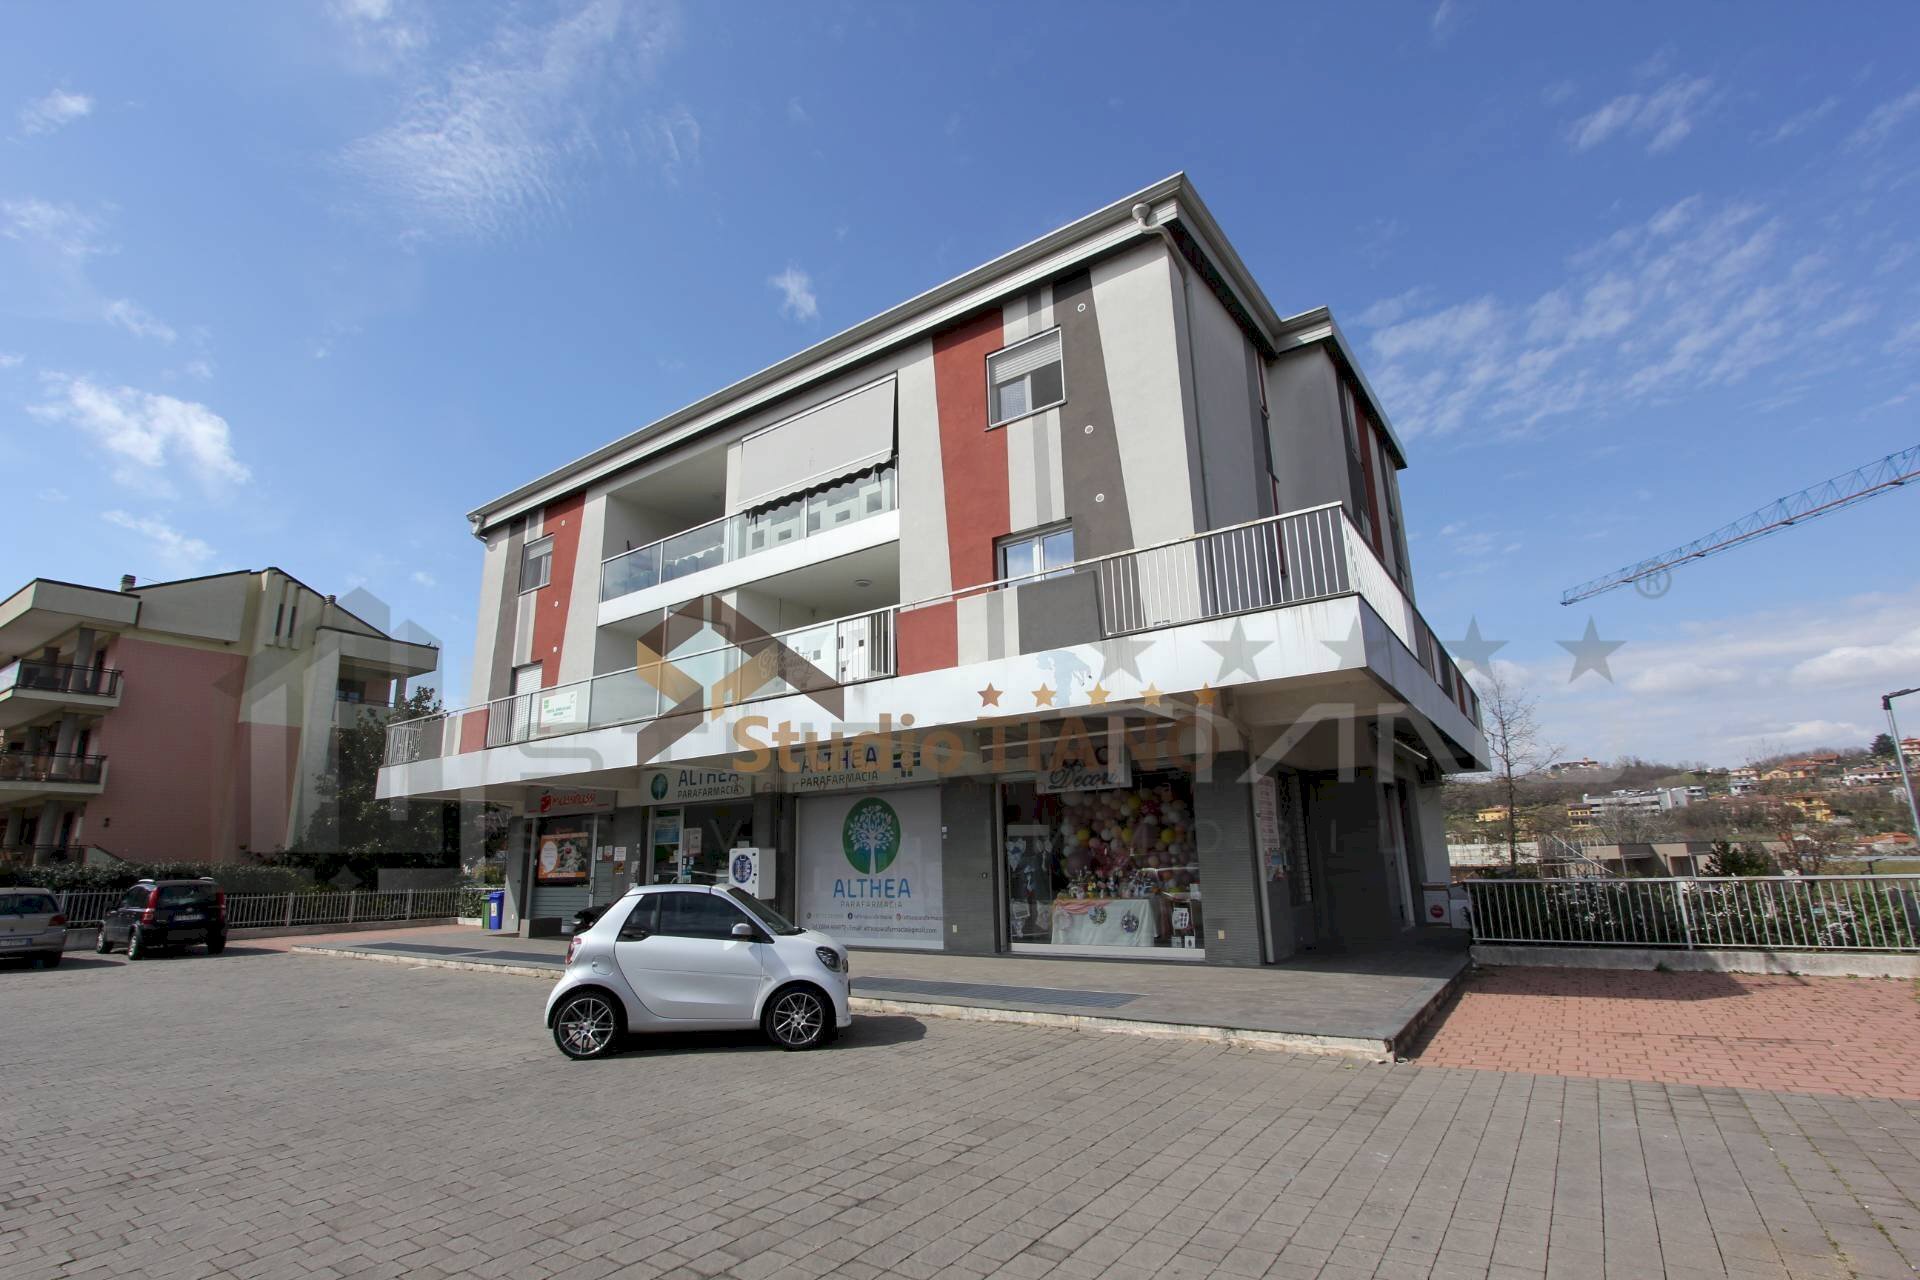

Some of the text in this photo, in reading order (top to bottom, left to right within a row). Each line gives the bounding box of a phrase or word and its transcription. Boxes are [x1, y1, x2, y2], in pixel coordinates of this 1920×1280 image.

[800, 770, 879, 788] PARAFARMACIA
[677, 784, 739, 800] PARAFARMACIA
[833, 878, 911, 899] ALTHEA
[840, 900, 903, 909] PARAFARMACIA
